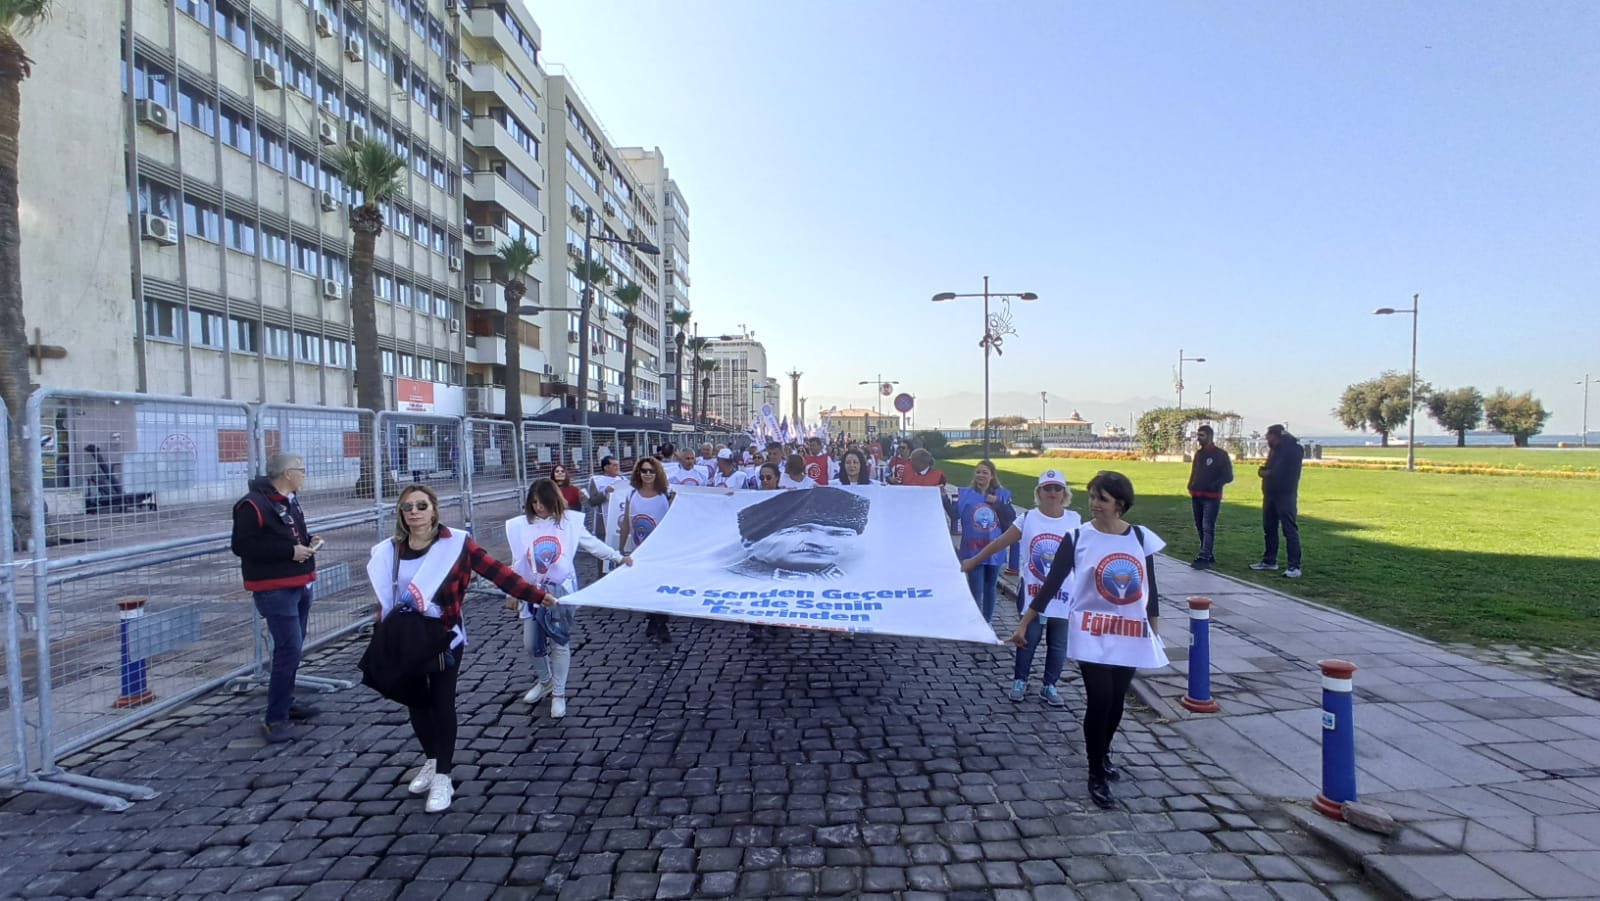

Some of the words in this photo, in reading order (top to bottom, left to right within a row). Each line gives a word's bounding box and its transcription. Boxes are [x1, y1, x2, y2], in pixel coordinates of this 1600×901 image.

[656, 585, 697, 597] Ne
[702, 588, 815, 599] Senden
[822, 587, 934, 600] Geçeriz
[750, 599, 789, 608] de
[796, 599, 883, 611] Senin
